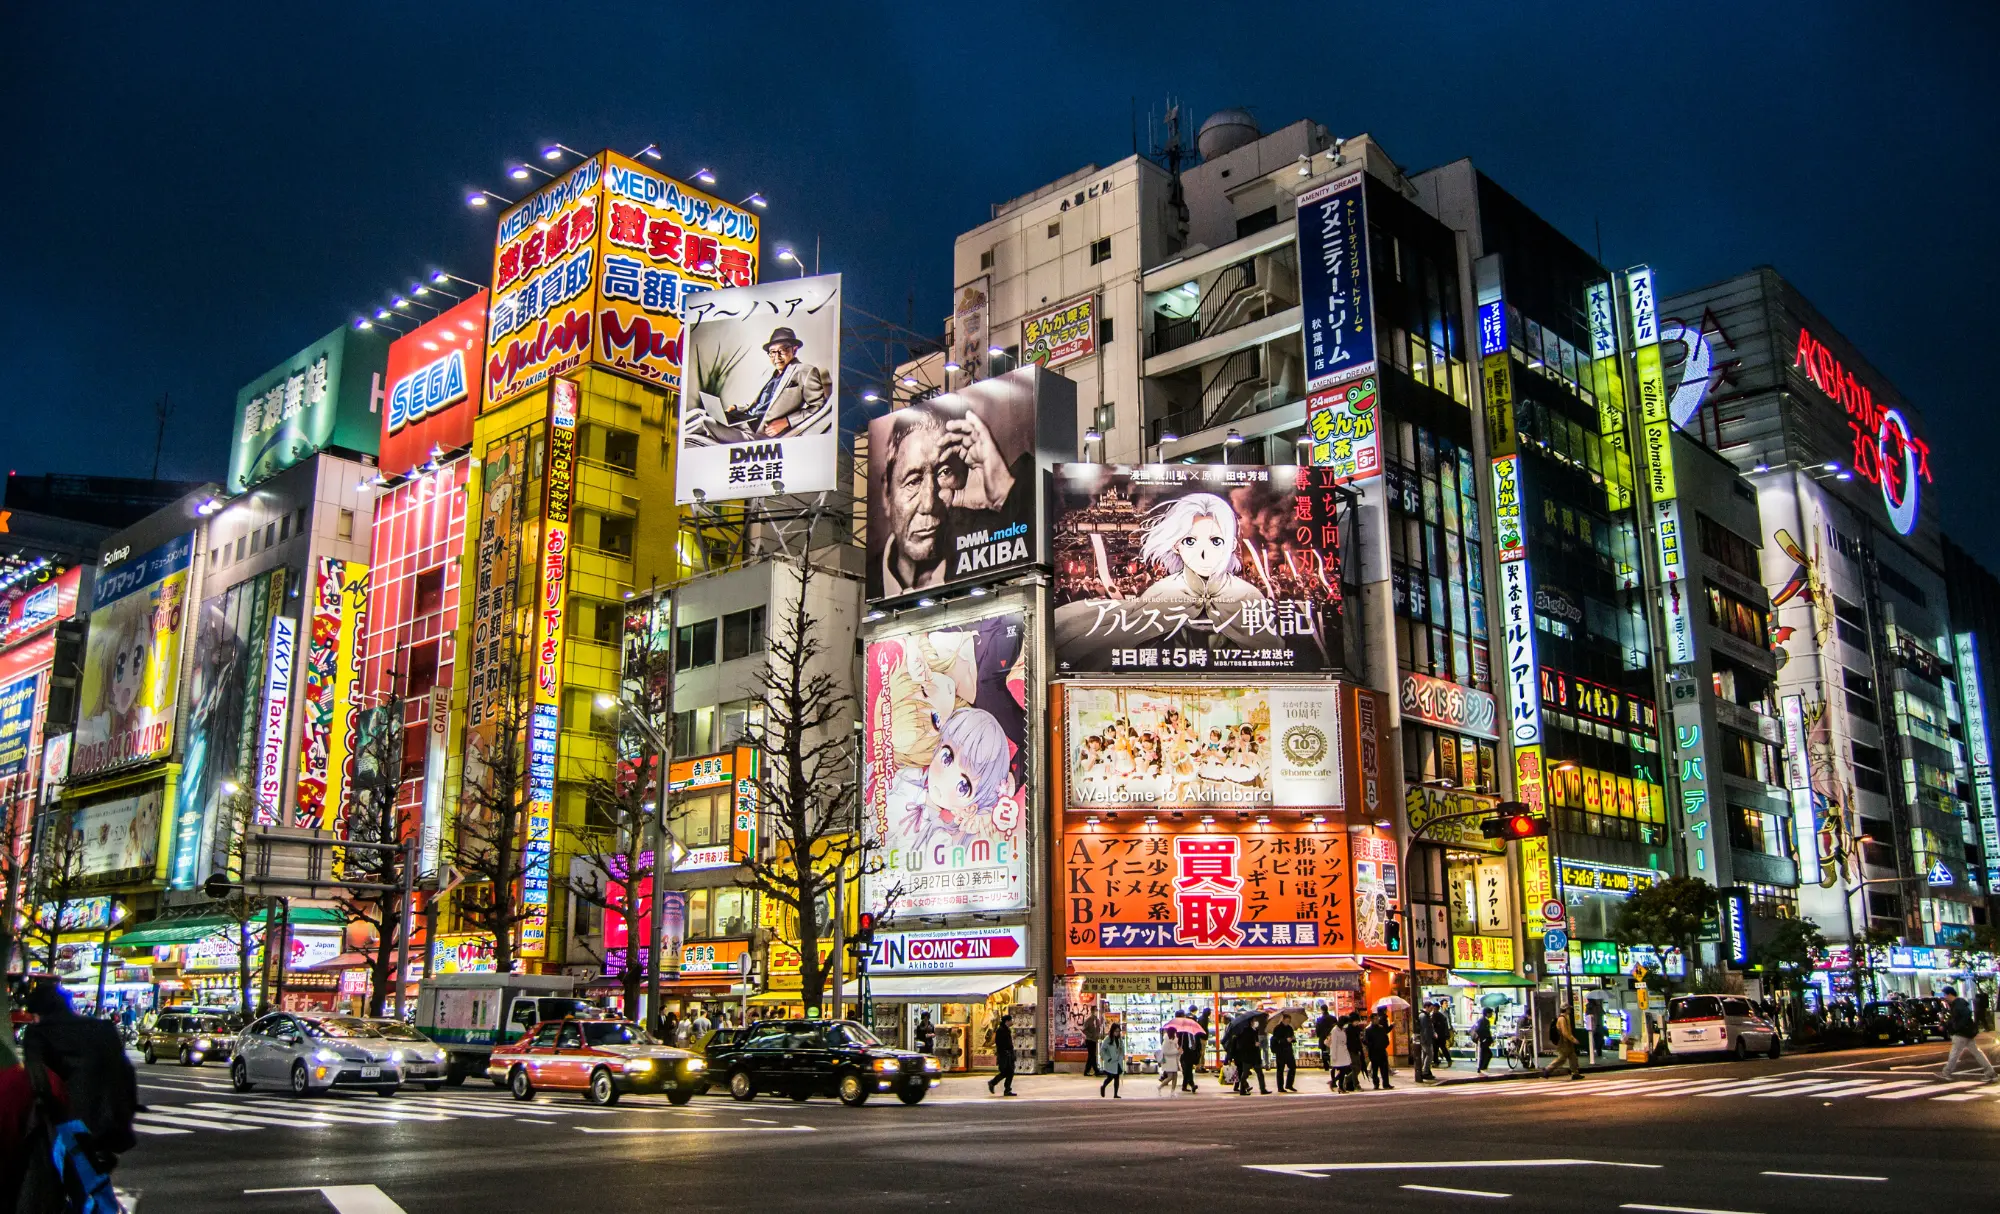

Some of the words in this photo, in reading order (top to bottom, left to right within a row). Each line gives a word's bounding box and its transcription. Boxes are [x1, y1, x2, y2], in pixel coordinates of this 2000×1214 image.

[500, 161, 600, 243] MEDIAリサイクル
[611, 166, 756, 242] MEDIAリサイクル
[1301, 187, 1330, 203] AMENITY
[1333, 175, 1358, 191] DREAM
[496, 195, 598, 292] 激安販売
[609, 200, 753, 287] 激安販売
[490, 250, 592, 345] 高額買取
[1320, 199, 1351, 366] アメニティードリーム
[1026, 303, 1090, 345] まんが喫茶
[1491, 303, 1502, 345] アメニティー
[1633, 278, 1653, 340] スーパービル
[1311, 318, 1324, 371] 秋葉原店
[1484, 318, 1494, 349] ドリーム
[488, 310, 592, 402] Mulan
[614, 355, 662, 380] ムーラン
[388, 350, 468, 433] SEGA
[525, 371, 547, 388] AKIBA
[1311, 375, 1342, 390] AMENITY
[1345, 365, 1372, 381] DREAM
[1643, 378, 1657, 418] Yellow
[554, 428, 573, 441] DVD
[1311, 408, 1374, 440] まんが
[554, 459, 568, 469] CD
[730, 443, 783, 464] DMM
[1313, 438, 1352, 462] 喫茶
[1648, 428, 1666, 494] Submarine
[729, 461, 783, 483] 英会話
[1226, 471, 1269, 481] 田中芳樹
[1496, 459, 1515, 504] まんが
[1403, 489, 1420, 514] 6F
[1659, 501, 1671, 511] 5F
[957, 522, 1028, 550] DMM.make
[1294, 465, 1319, 588] 奪還の刃。
[956, 538, 1029, 576] AKIBA
[97, 560, 148, 600] ソフマップ
[470, 517, 497, 727] 激安販売の専門店
[1084, 598, 1315, 641] アルスラーン戦記
[1410, 591, 1426, 616] 5F
[245, 577, 267, 716] メロンブックス
[275, 621, 292, 678] AKKY
[1122, 648, 1159, 666] 日曜
[1172, 648, 1208, 667] 5時
[1213, 648, 1294, 660] TVアニメ放送中
[433, 693, 448, 734] GAME
[1401, 676, 1496, 730] メイドカジノ
[123, 730, 140, 760] ON
[138, 721, 168, 755] AIR!
[266, 696, 287, 777] Tax-free
[873, 729, 888, 847] 見られてますよ!
[1075, 787, 1155, 803] Welcome
[1161, 788, 1177, 802] to
[1184, 786, 1273, 803] Akihabara
[1677, 724, 1707, 871] リバティー
[1099, 838, 1121, 918] アイドル
[1122, 838, 1146, 897] アニメ
[1145, 838, 1171, 920] 美少女系
[1247, 838, 1269, 920] フィギュア
[1270, 838, 1290, 897] ホビー
[1293, 838, 1319, 920] 携帯電話
[1067, 838, 1096, 945] AKBもの
[1175, 838, 1243, 947] 買取
[1318, 838, 1345, 946] アップルとか
[1487, 878, 1500, 927] ルノアール
[1546, 904, 1559, 915] 40
[524, 929, 545, 940] AKIBA
[1101, 925, 1172, 946] チケット
[1248, 924, 1316, 946] 大黒屋
[1549, 934, 1557, 948] P
[1728, 897, 1741, 961] GALLERIA
[871, 934, 905, 969] ZIN
[910, 940, 963, 959] COMIC
[967, 939, 991, 957] ZIN
[908, 961, 954, 969] Akihabara
[1583, 949, 1616, 965] リバティー
[1157, 976, 1203, 984] WESTERN
